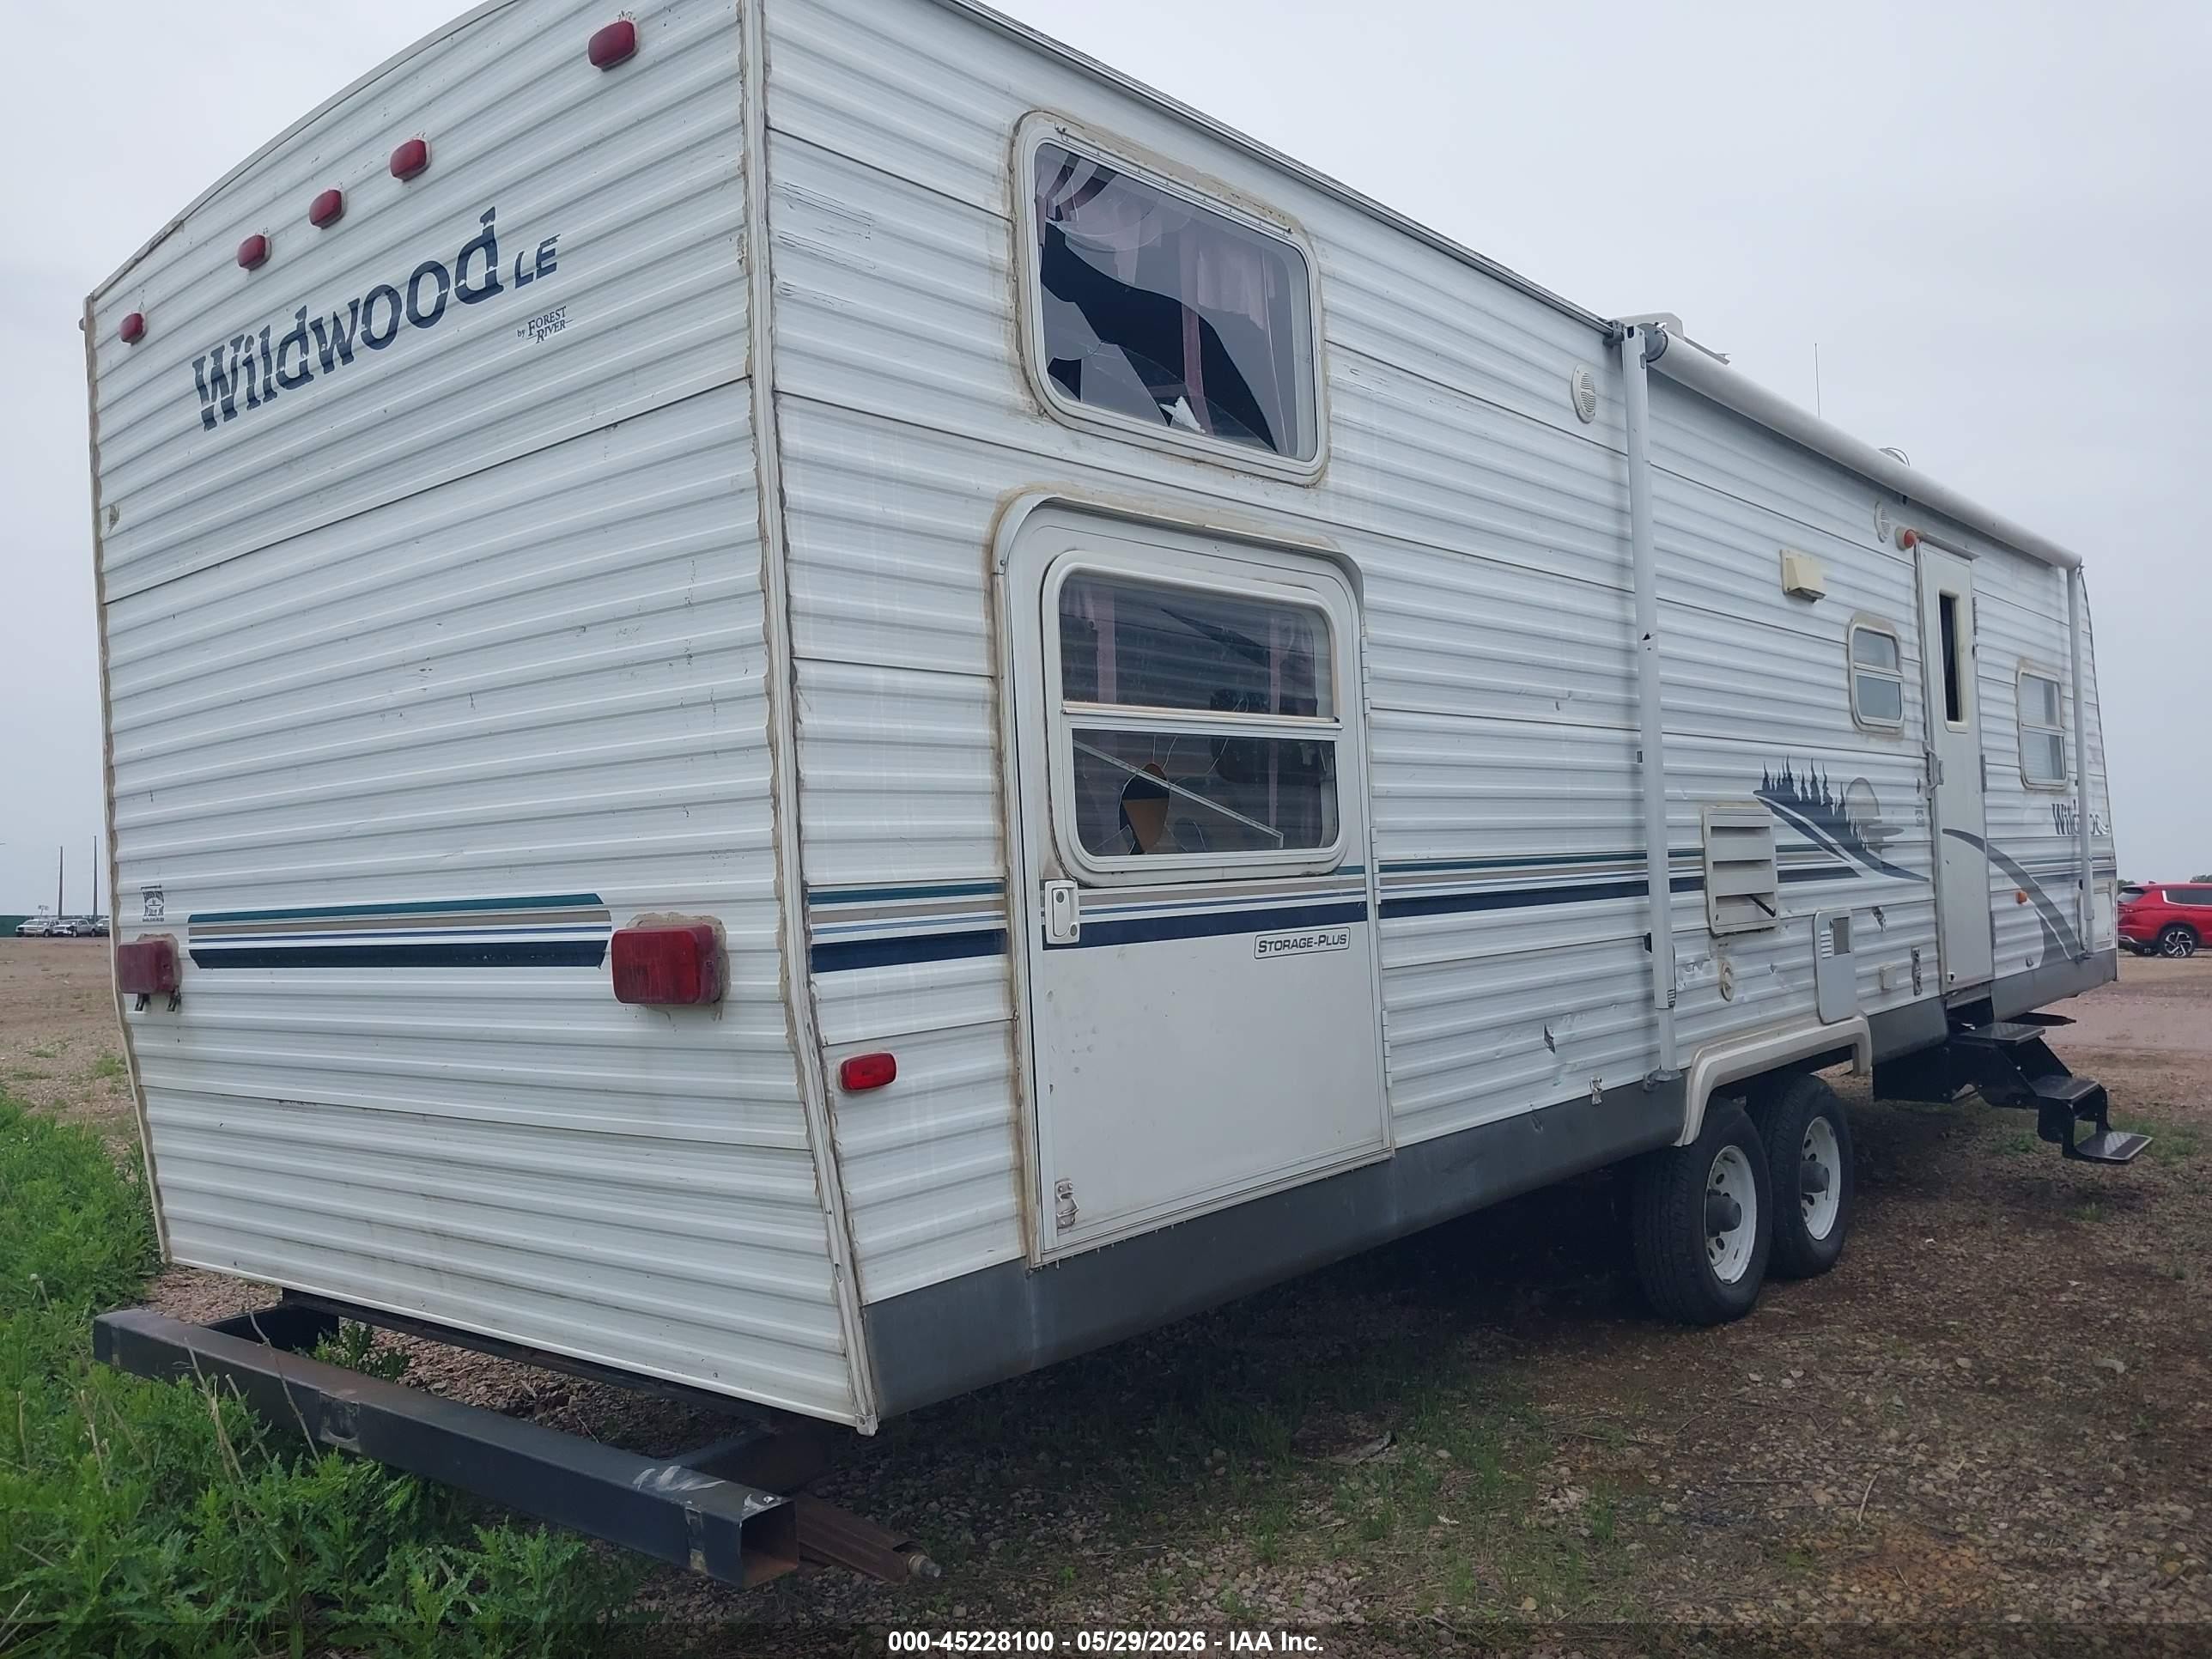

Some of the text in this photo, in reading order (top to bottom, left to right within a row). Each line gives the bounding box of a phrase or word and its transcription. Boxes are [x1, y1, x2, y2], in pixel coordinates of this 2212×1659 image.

[192, 206, 561, 431] Wildwood LE
[517, 306, 567, 337] by FOREST
[536, 319, 566, 344] RIVER
[1258, 933, 1347, 953] STORAGE-PLUS
